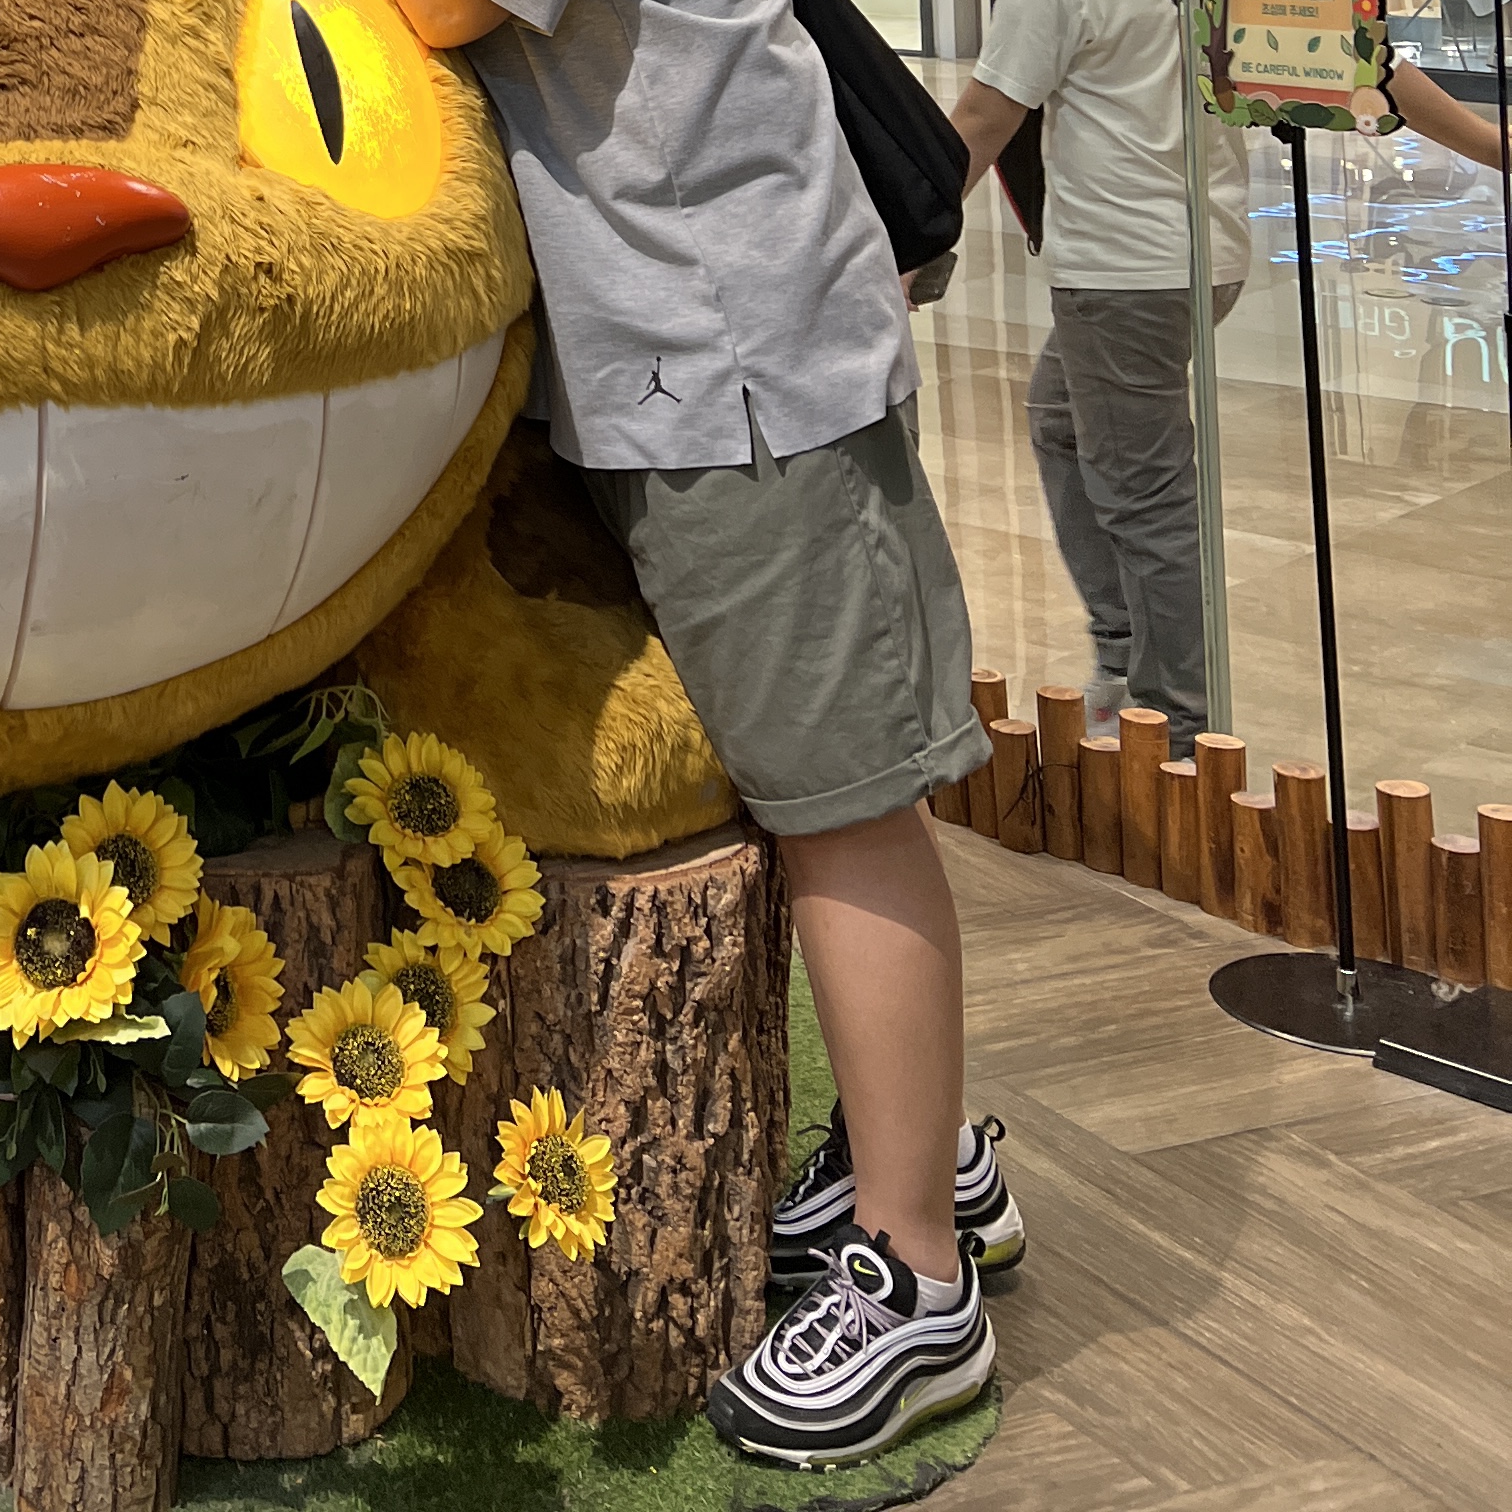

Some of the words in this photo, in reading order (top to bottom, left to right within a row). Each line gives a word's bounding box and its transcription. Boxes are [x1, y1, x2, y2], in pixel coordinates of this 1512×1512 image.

[1241, 61, 1253, 73] BE
[1255, 62, 1301, 77] CAREFUL
[1303, 66, 1345, 81] WINDOW
